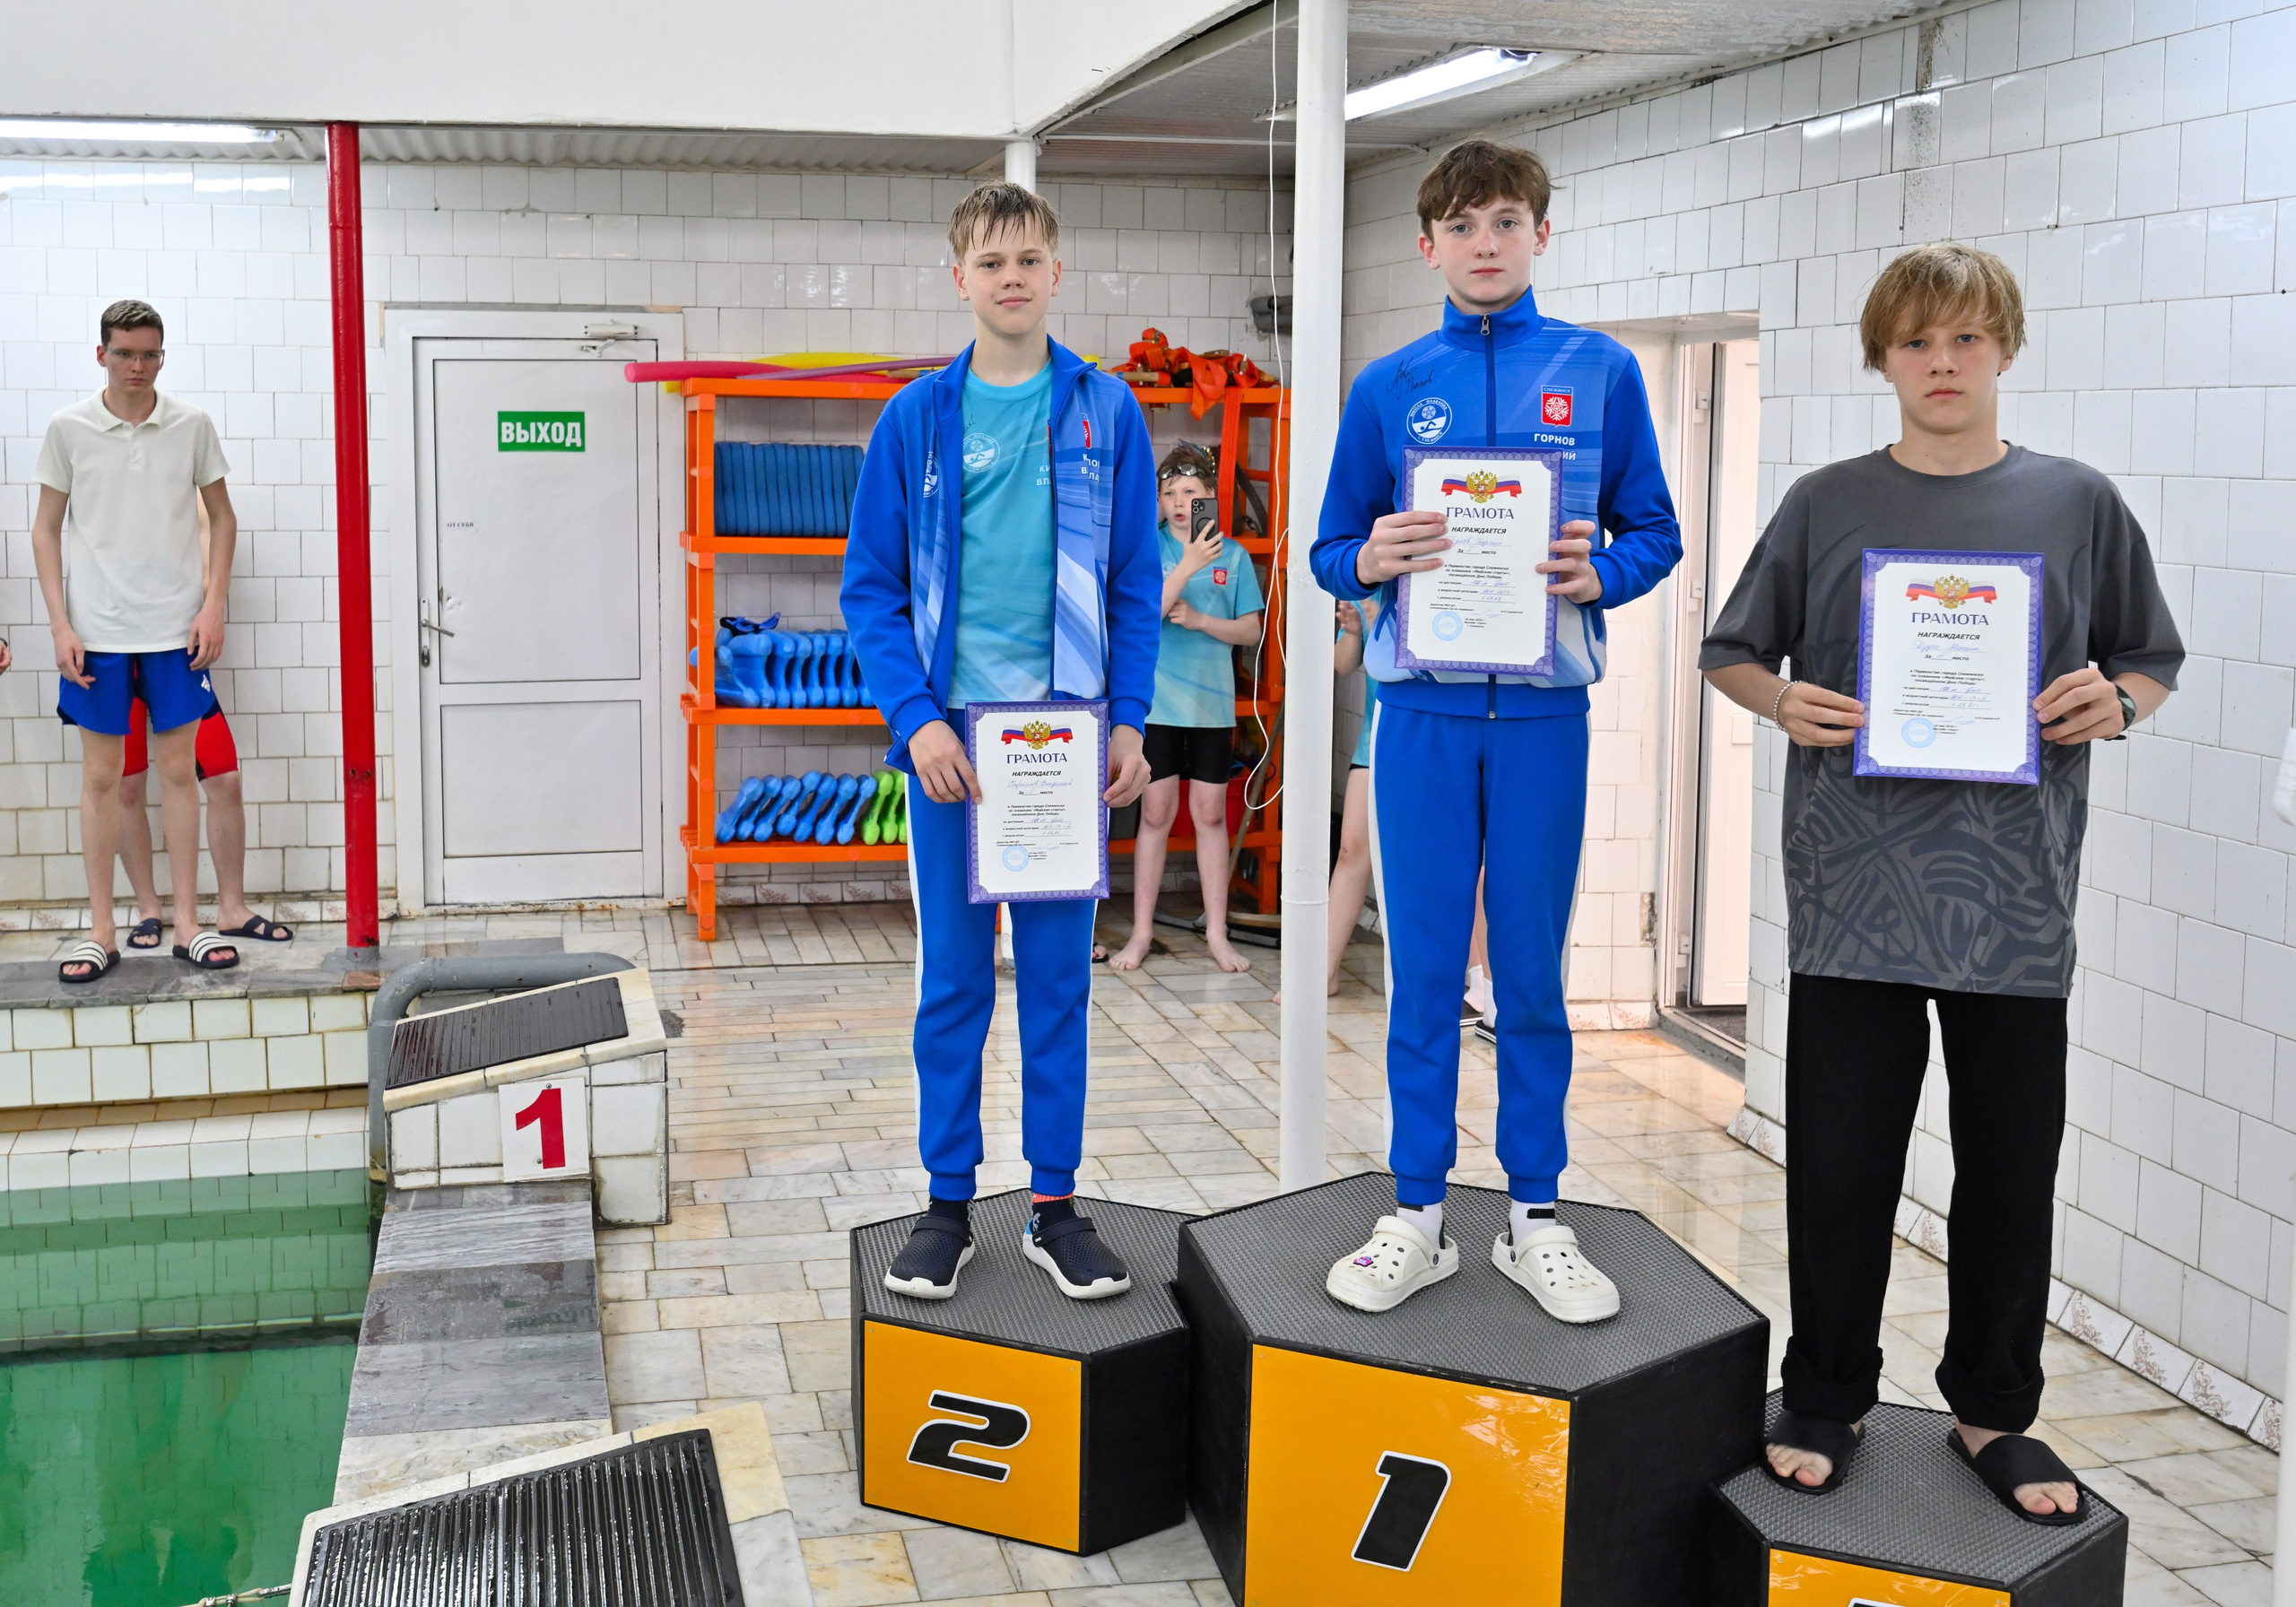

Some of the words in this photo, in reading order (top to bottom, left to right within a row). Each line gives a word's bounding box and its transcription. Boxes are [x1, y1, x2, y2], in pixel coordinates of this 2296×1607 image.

[500, 421, 582, 447] ВЫХОД
[1534, 433, 1575, 446] ГОРНОВ
[1562, 450, 1576, 461] ИЙ
[1039, 465, 1050, 473] КИ
[1036, 477, 1049, 485] ВЛ
[1446, 507, 1515, 519] ГРАМОТА
[1451, 526, 1507, 534] НАГРАЖДАЕТСЯ
[1911, 612, 1989, 626] ГРАМОТА
[1918, 631, 1980, 640] НАГРАЖДАЕТСЯ
[1006, 752, 1067, 764] ГРАМОТА
[515, 1087, 566, 1169] 1
[906, 1388, 1031, 1483] 2
[1352, 1449, 1450, 1572] 1
